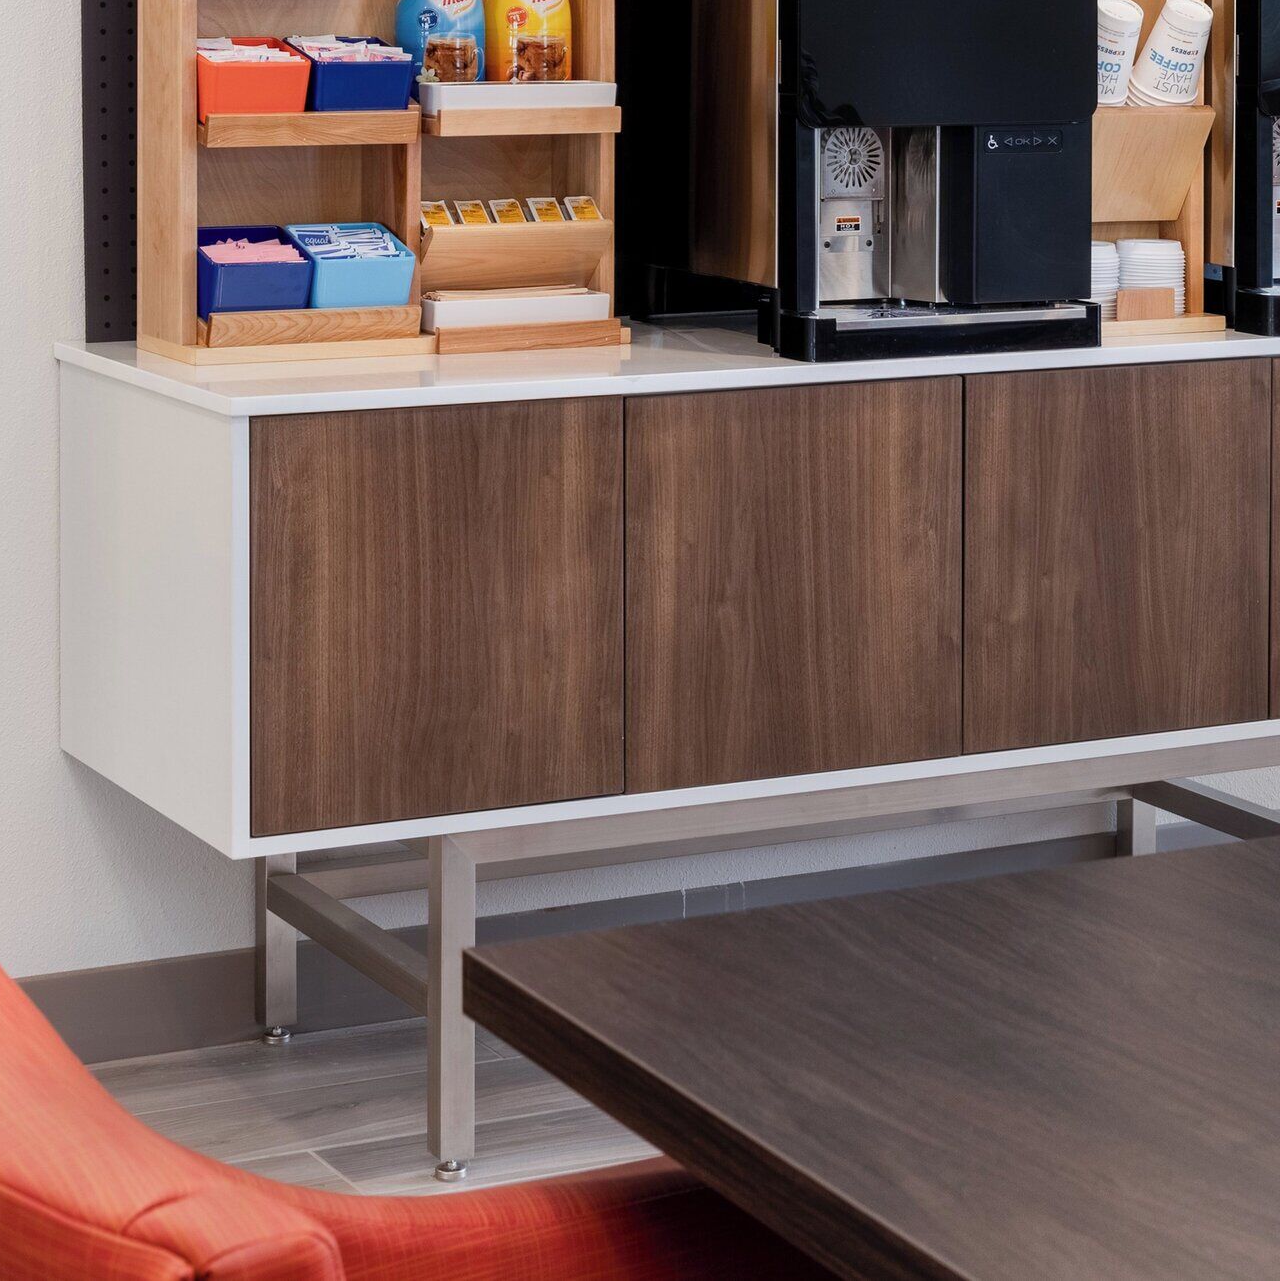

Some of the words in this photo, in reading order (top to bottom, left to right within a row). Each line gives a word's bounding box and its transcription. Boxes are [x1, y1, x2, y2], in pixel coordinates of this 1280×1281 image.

[1171, 46, 1199, 56] EXPRESS
[1015, 138, 1031, 146] OK
[305, 236, 329, 246] equal
